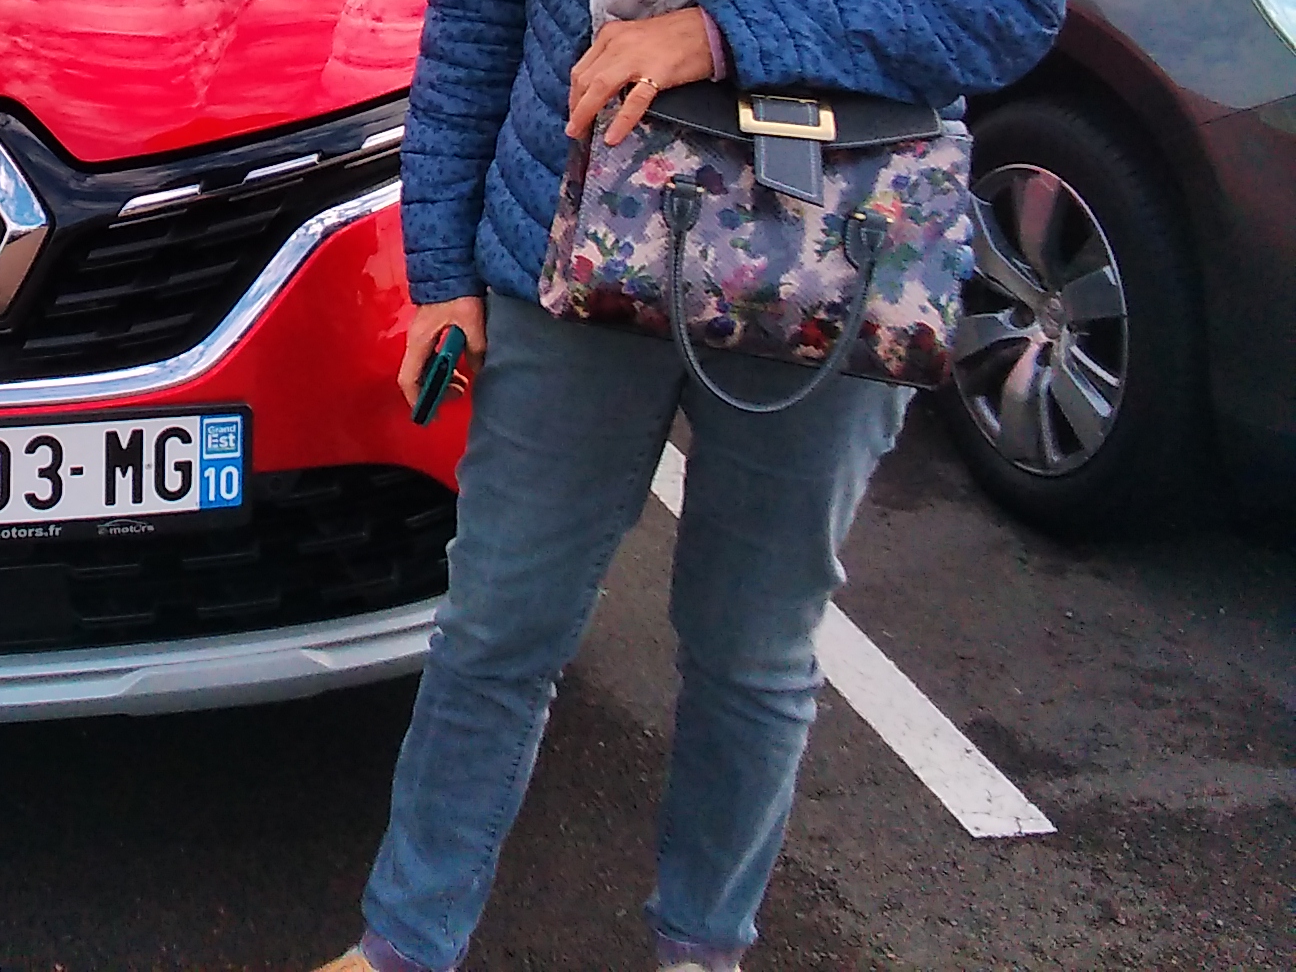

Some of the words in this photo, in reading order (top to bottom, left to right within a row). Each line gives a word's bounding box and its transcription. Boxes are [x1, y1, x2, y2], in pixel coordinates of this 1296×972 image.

[207, 424, 237, 434] Grand
[207, 433, 236, 449] Est
[203, 465, 239, 502] 10
